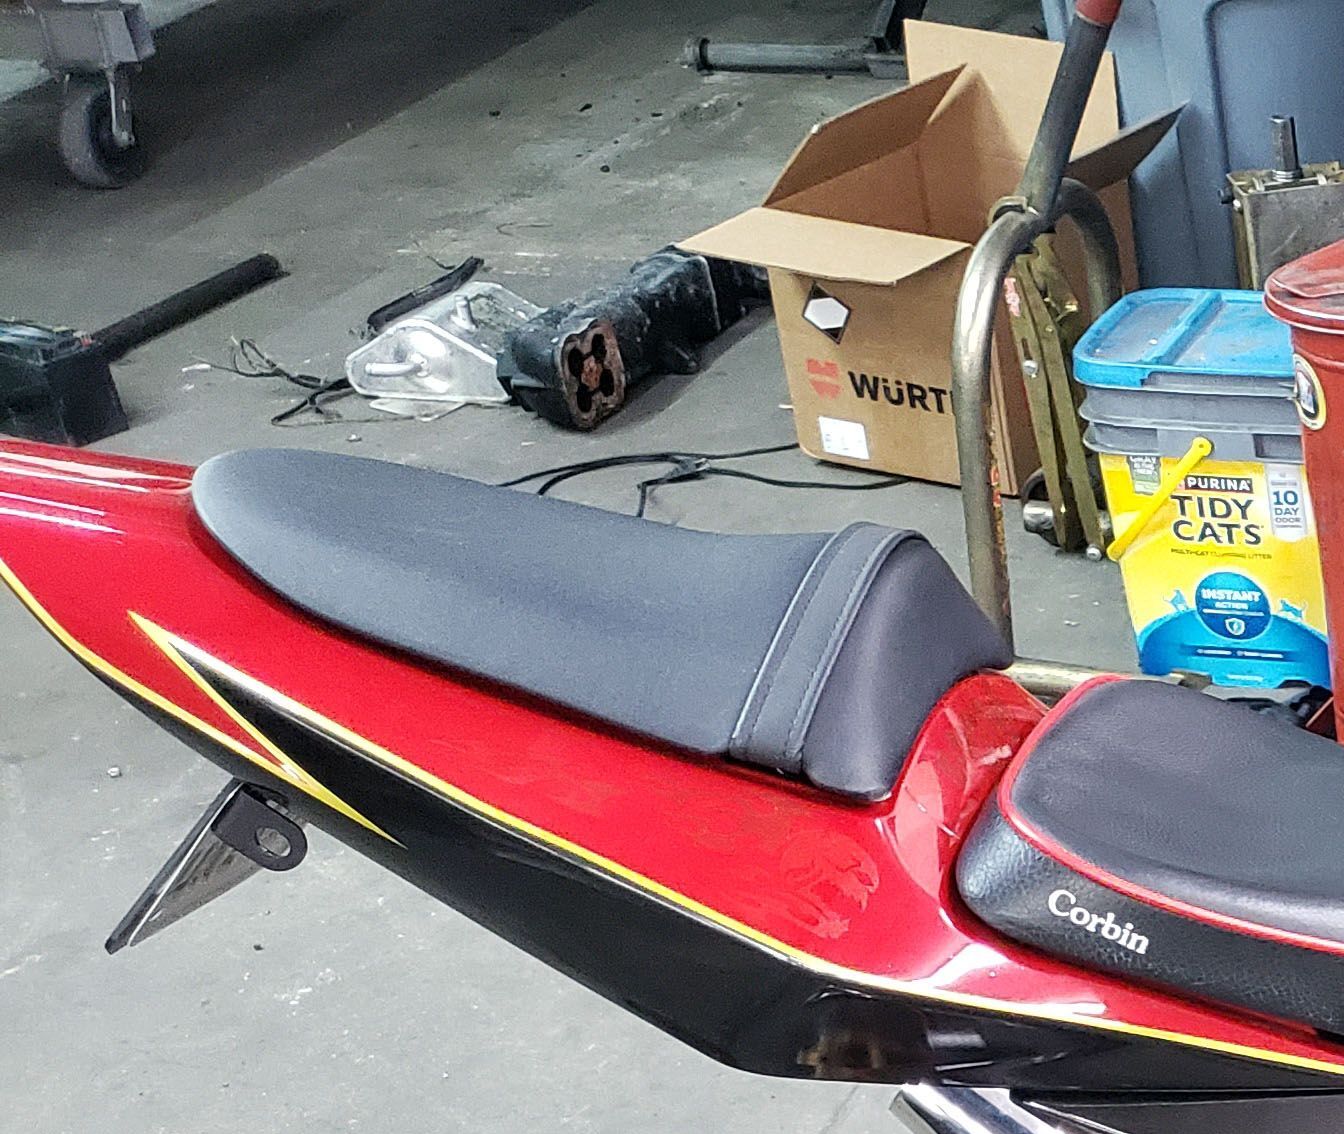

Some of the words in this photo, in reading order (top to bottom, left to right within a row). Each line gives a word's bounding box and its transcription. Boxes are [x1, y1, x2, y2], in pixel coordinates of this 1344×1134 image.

[847, 371, 953, 414] WÜRT
[1187, 476, 1251, 491] PURINA
[1170, 494, 1254, 520] TIDY
[1273, 490, 1299, 505] 10
[1274, 507, 1300, 516] DAY
[1173, 519, 1262, 545] CATS
[1201, 588, 1262, 602] INSTANT
[1047, 888, 1149, 955] Corbin
